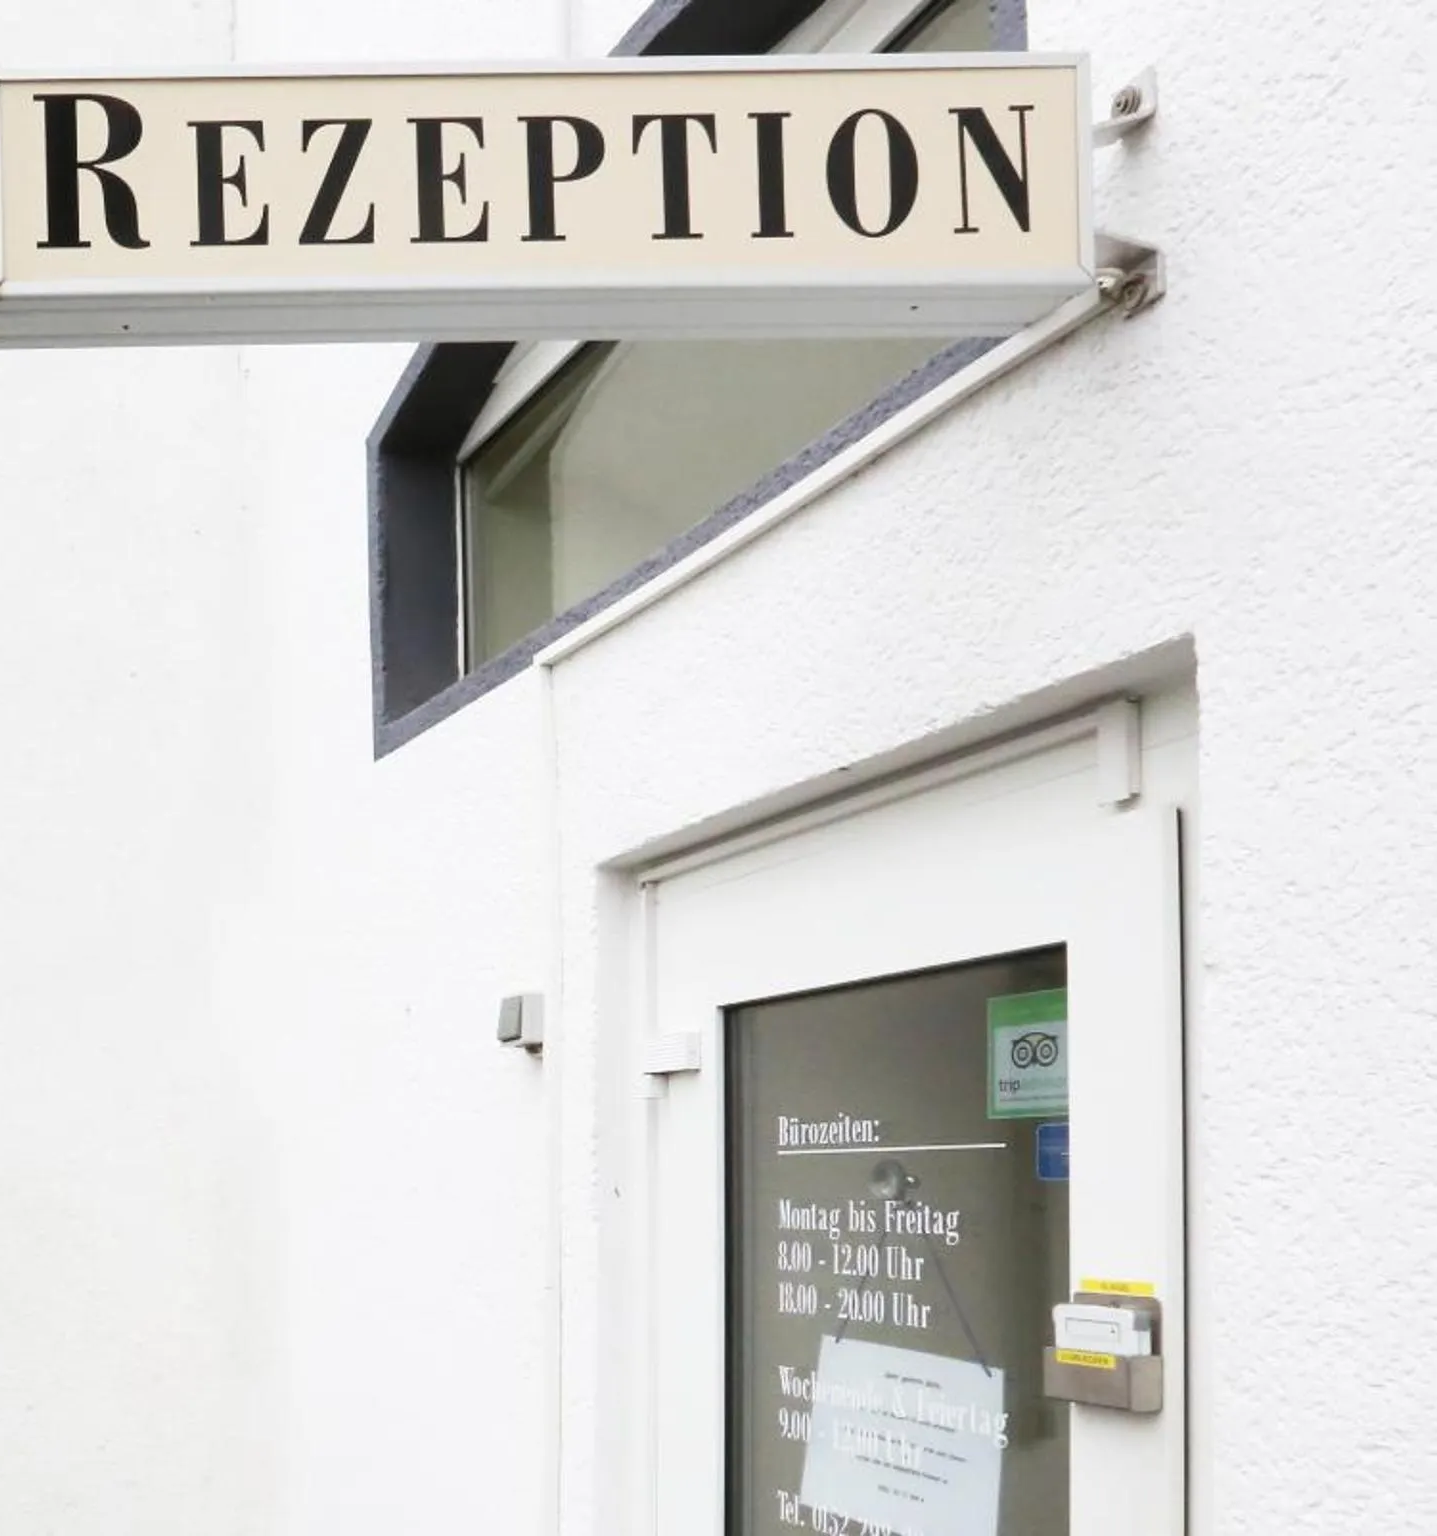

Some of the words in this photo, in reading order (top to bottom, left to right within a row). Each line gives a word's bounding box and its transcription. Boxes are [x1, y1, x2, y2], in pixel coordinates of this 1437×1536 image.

[33, 92, 1035, 250] REZEPTION
[778, 1112, 880, 1146] Bürozeiten:
[778, 1199, 841, 1240] Montag
[849, 1200, 876, 1232] bis
[884, 1200, 960, 1246] Freitag
[777, 1240, 811, 1272] 8.00
[832, 1243, 879, 1277] 12.00
[886, 1246, 924, 1281] Uhr
[777, 1281, 817, 1315] 18.00
[837, 1288, 885, 1323] 20.00
[892, 1292, 931, 1329] Uhr
[778, 1407, 812, 1441] 9.00
[777, 1489, 805, 1527] Tel.
